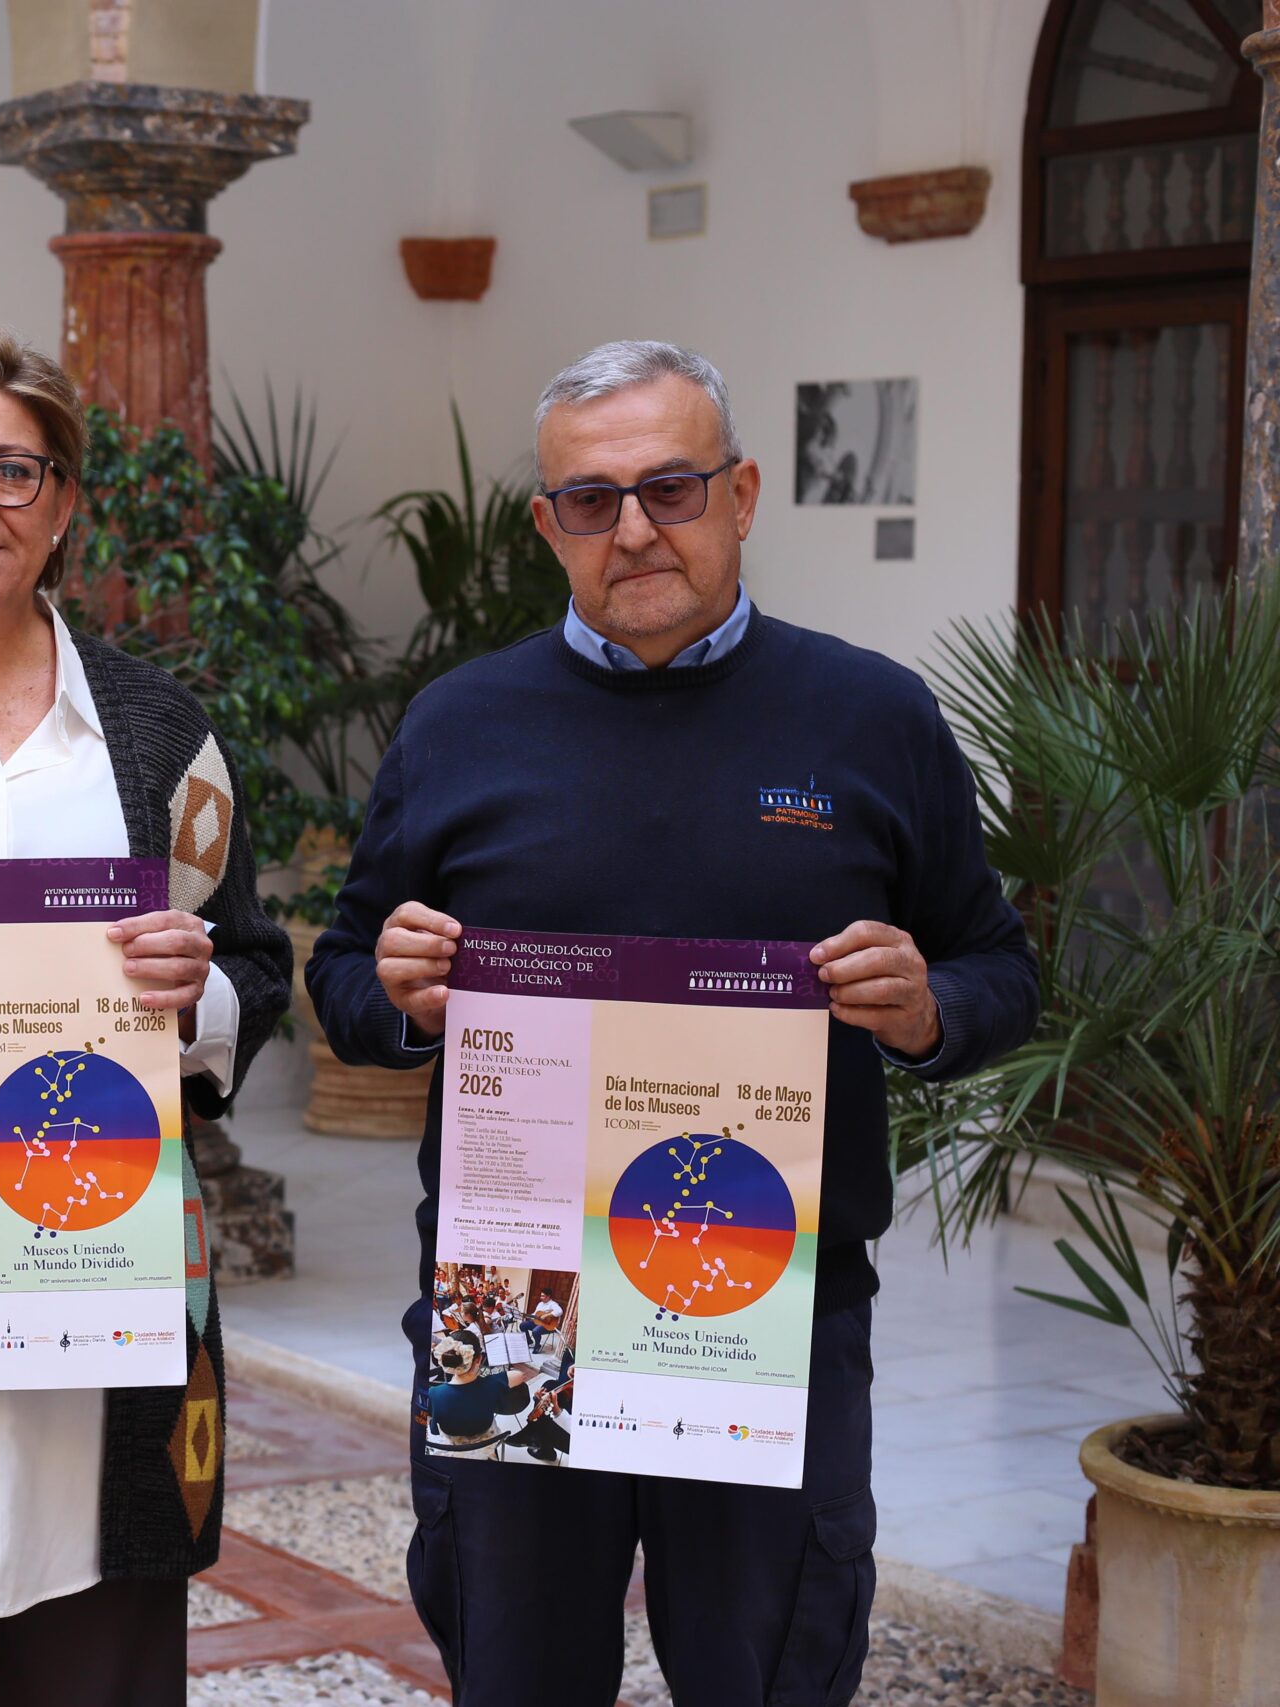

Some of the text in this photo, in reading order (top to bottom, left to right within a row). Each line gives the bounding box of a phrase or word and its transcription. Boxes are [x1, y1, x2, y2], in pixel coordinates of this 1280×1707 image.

[464, 937, 611, 959] MUSEO ARQUEOLÓGICO
[478, 955, 593, 971] Y ETNOLÓGICO DE
[511, 973, 562, 985] LUCENA
[689, 970, 749, 978] AYUNTAMIENTO
[95, 997, 109, 1012] 18
[113, 997, 128, 1012] de
[12, 1018, 62, 1033] Museos
[114, 1016, 165, 1031] de 2026
[460, 1027, 514, 1052] ACTOS
[482, 1053, 572, 1067] INTERNACIONAL
[460, 1062, 541, 1076] DE LOS MUSEOS
[459, 1072, 502, 1097] 2026
[605, 1074, 719, 1097] Día Internacional
[736, 1083, 811, 1106] 18 de Mayo
[604, 1095, 700, 1116] de los Museos
[755, 1104, 810, 1122] de 2026
[605, 1117, 639, 1130] ICOM
[22, 1243, 124, 1256] Museos Uniendo
[13, 1256, 134, 1270] un Mundo Dividido
[642, 1325, 748, 1346] Museos Uniendo
[631, 1341, 757, 1362] un Mundo Dividido
